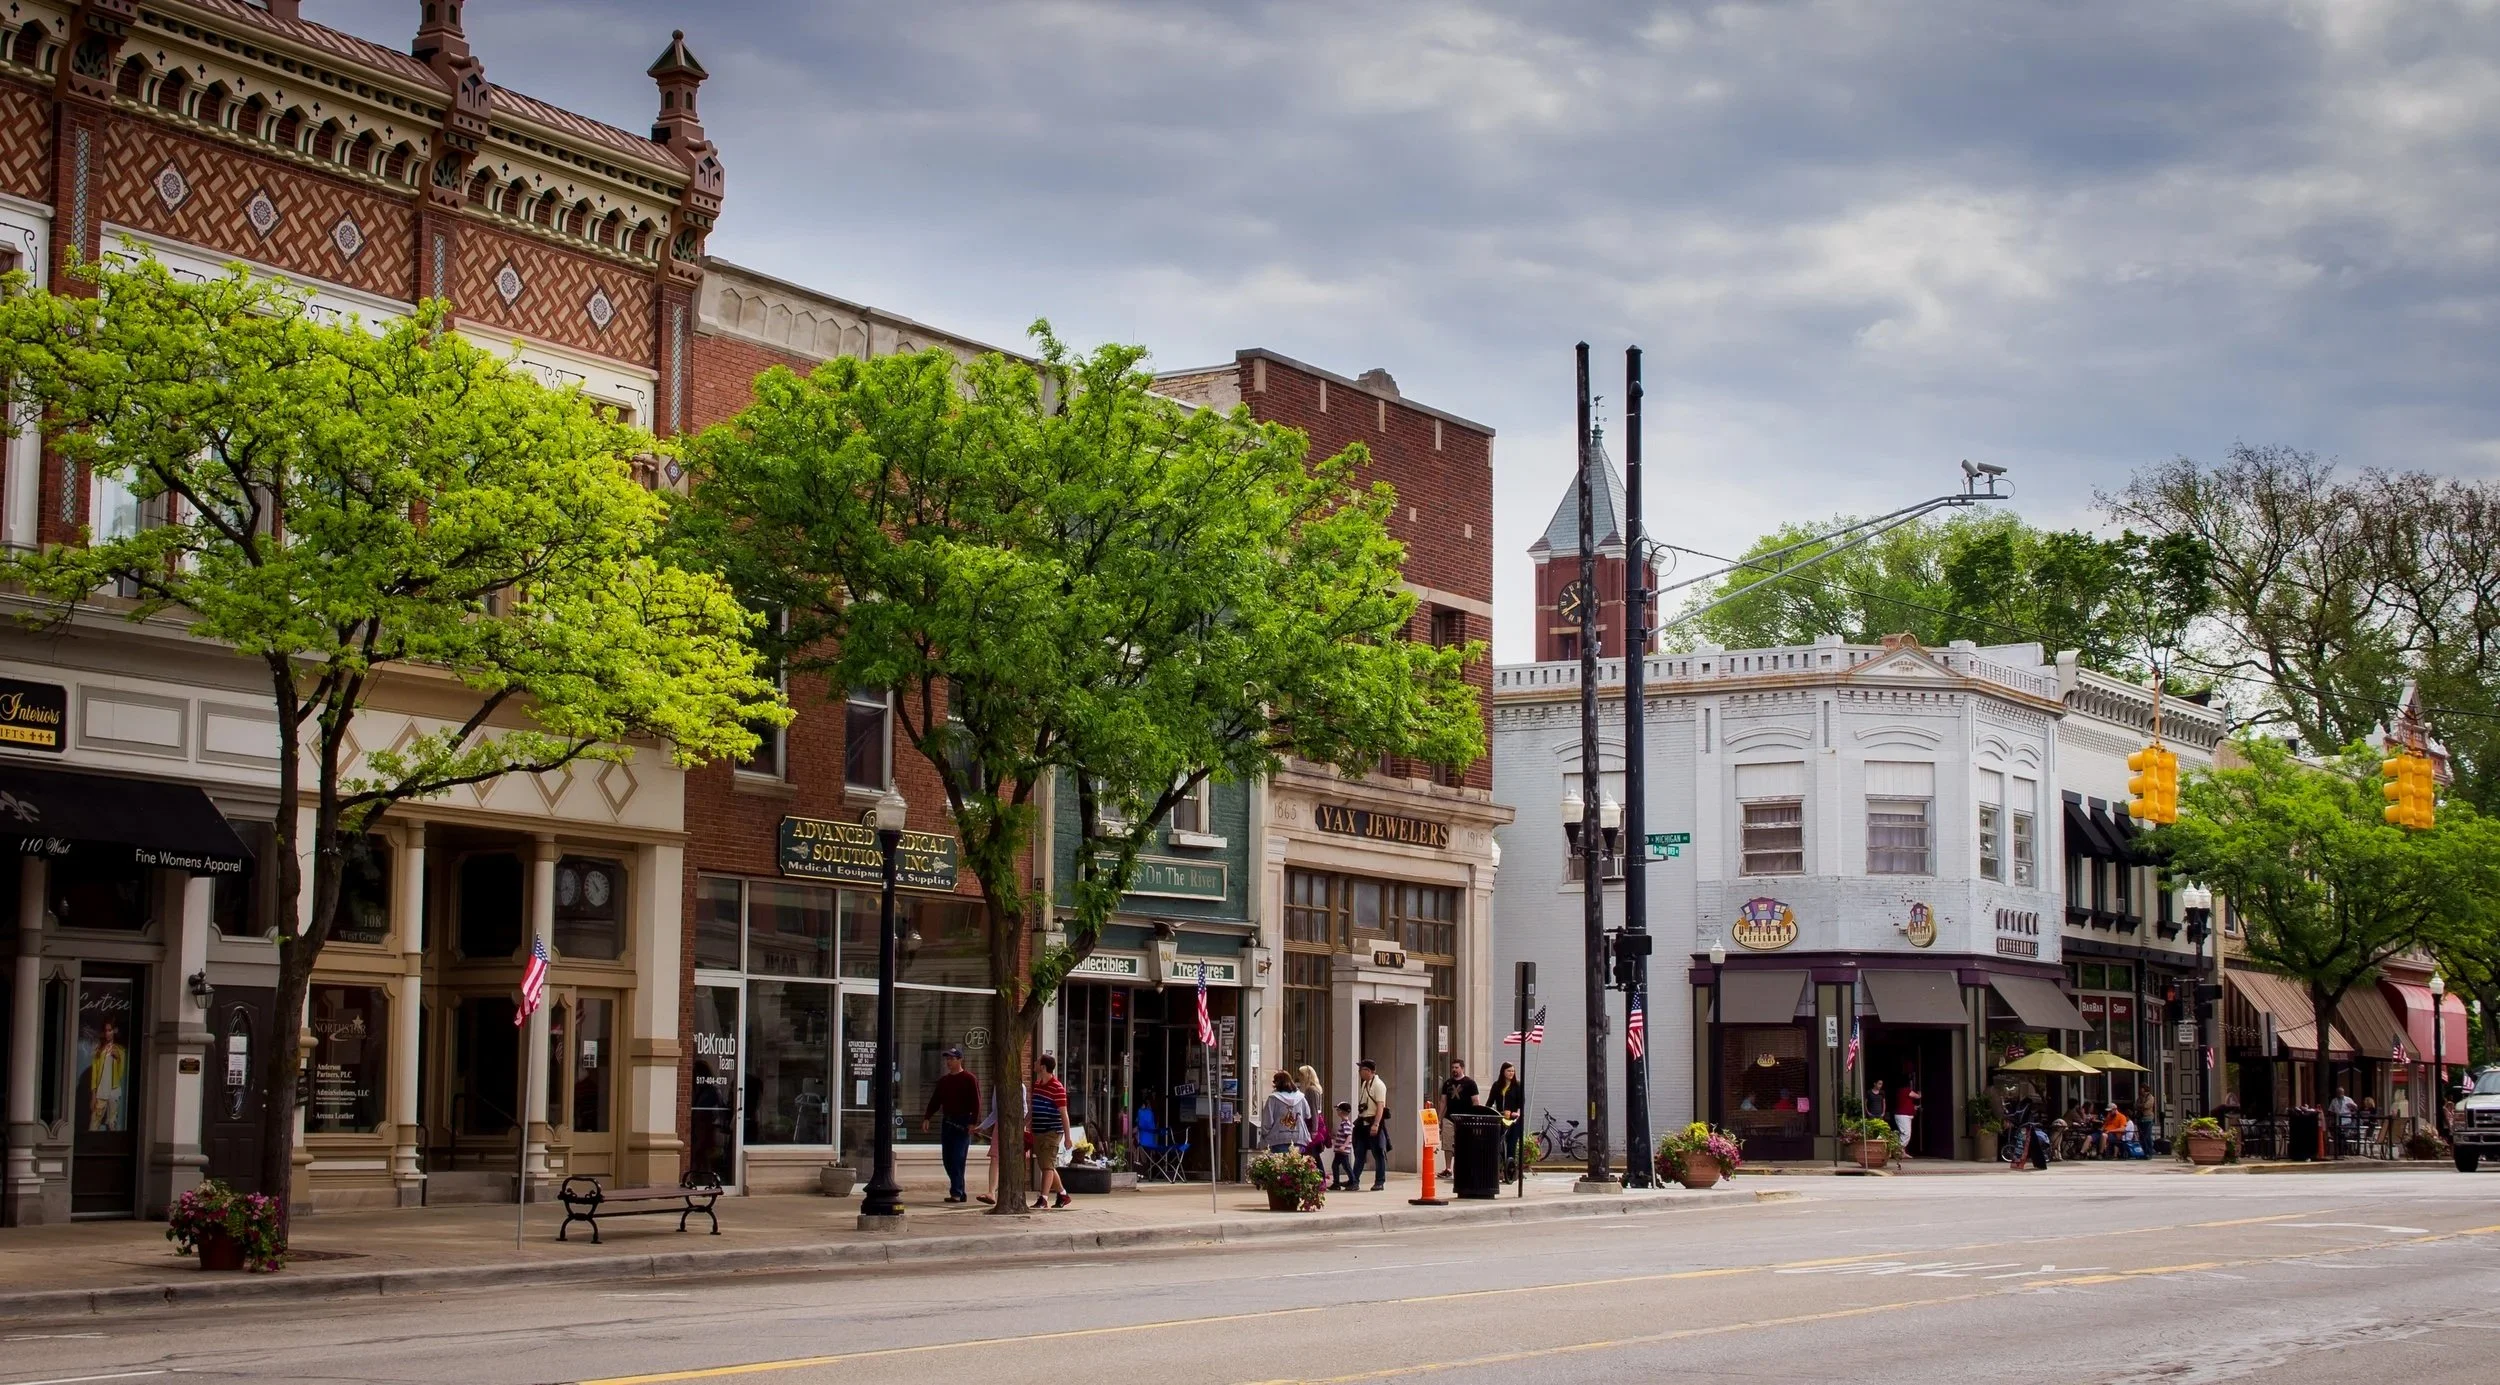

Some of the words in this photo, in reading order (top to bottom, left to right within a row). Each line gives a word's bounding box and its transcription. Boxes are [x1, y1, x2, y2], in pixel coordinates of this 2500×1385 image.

[0, 693, 60, 724] Interiors
[1273, 801, 1297, 820] 1865
[1321, 805, 1357, 834] YAX
[1366, 813, 1449, 848] JEWELERS
[20, 838, 43, 852] 110
[793, 821, 876, 846] ADVANCED
[895, 834, 949, 855] EDICAL
[1467, 832, 1484, 848] 1915
[1655, 834, 1681, 844] MICHIGAN
[136, 849, 156, 864] Fine
[160, 851, 201, 868] Womens
[204, 856, 242, 873] Apparel
[812, 844, 899, 871] SOLUTION,
[904, 854, 932, 873] INC.
[787, 860, 832, 873] Medical
[908, 873, 951, 886] Supplies
[1146, 865, 1162, 885] On
[1165, 866, 1185, 886] The
[1190, 869, 1217, 889] River
[1738, 925, 1792, 936] UPTOWN
[1378, 953, 1390, 965] 102
[1177, 962, 1224, 979] Treaures
[698, 1032, 736, 1055] DeKroub
[965, 1031, 991, 1045] OPEN
[718, 1055, 735, 1070] Team
[1175, 1084, 1195, 1095] OPEN
